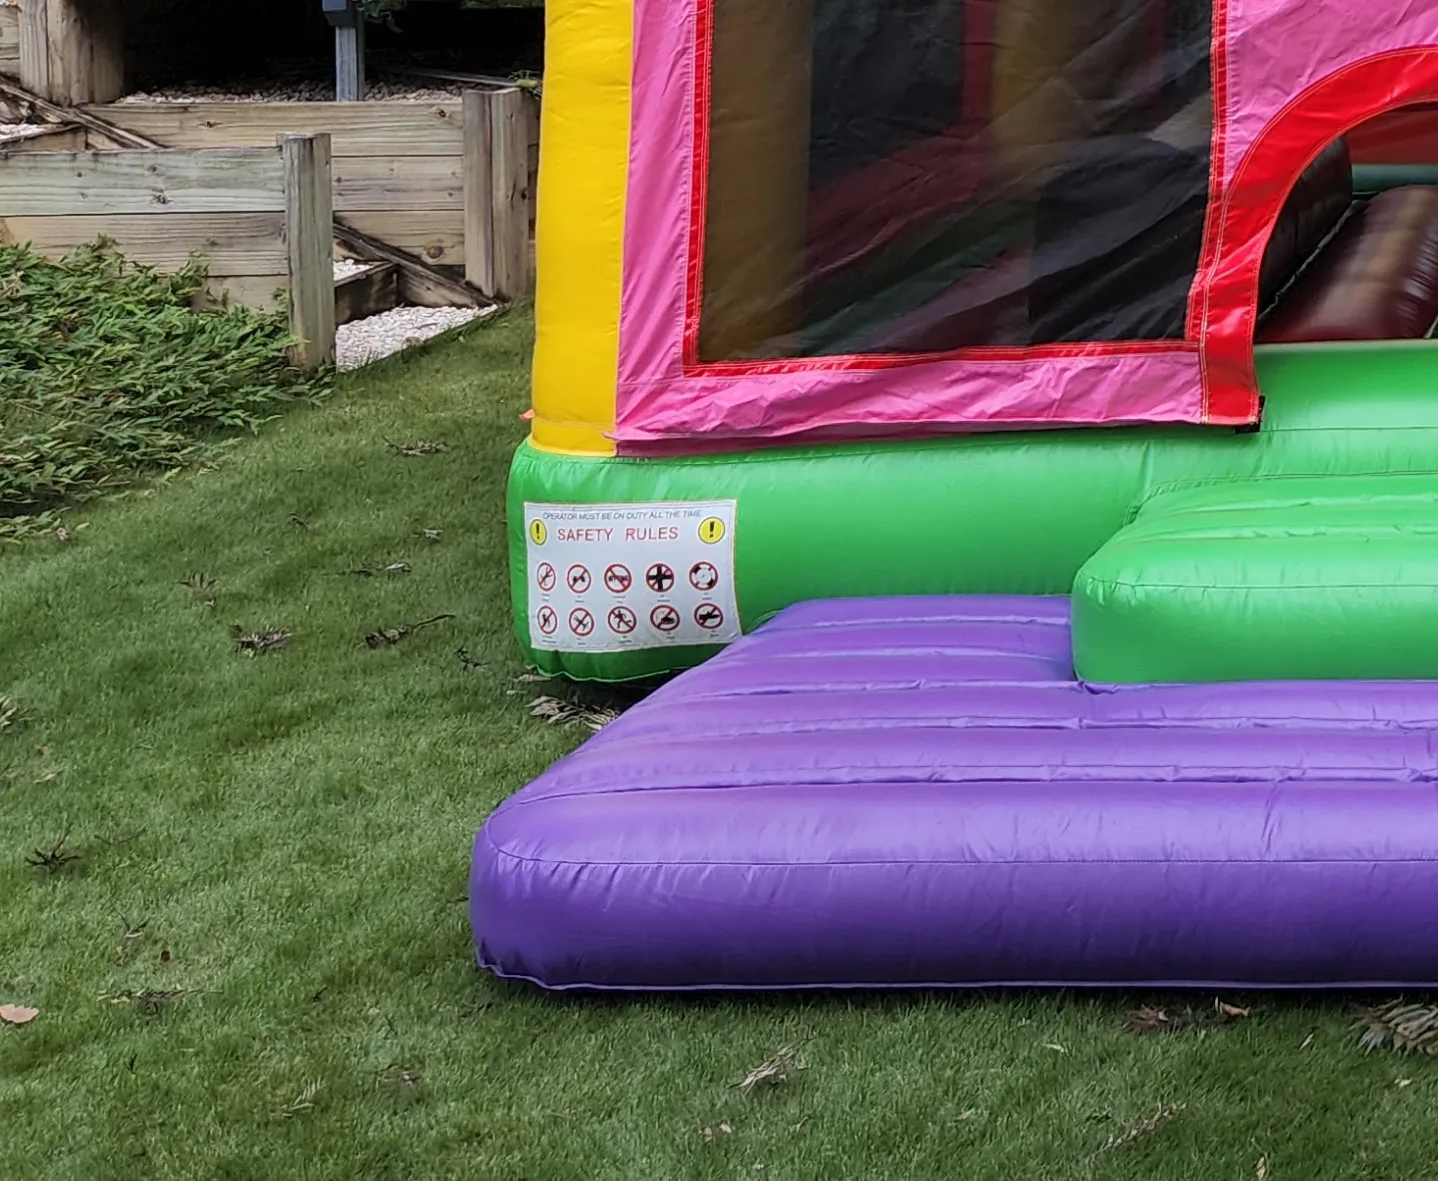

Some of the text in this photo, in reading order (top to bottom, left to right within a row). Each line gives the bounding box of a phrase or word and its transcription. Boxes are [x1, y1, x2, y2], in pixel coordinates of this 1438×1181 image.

[542, 509, 702, 521] OPERATOR MUST BE ON DUTY ALL THE TIME
[557, 526, 679, 542] SAFETY RULES
